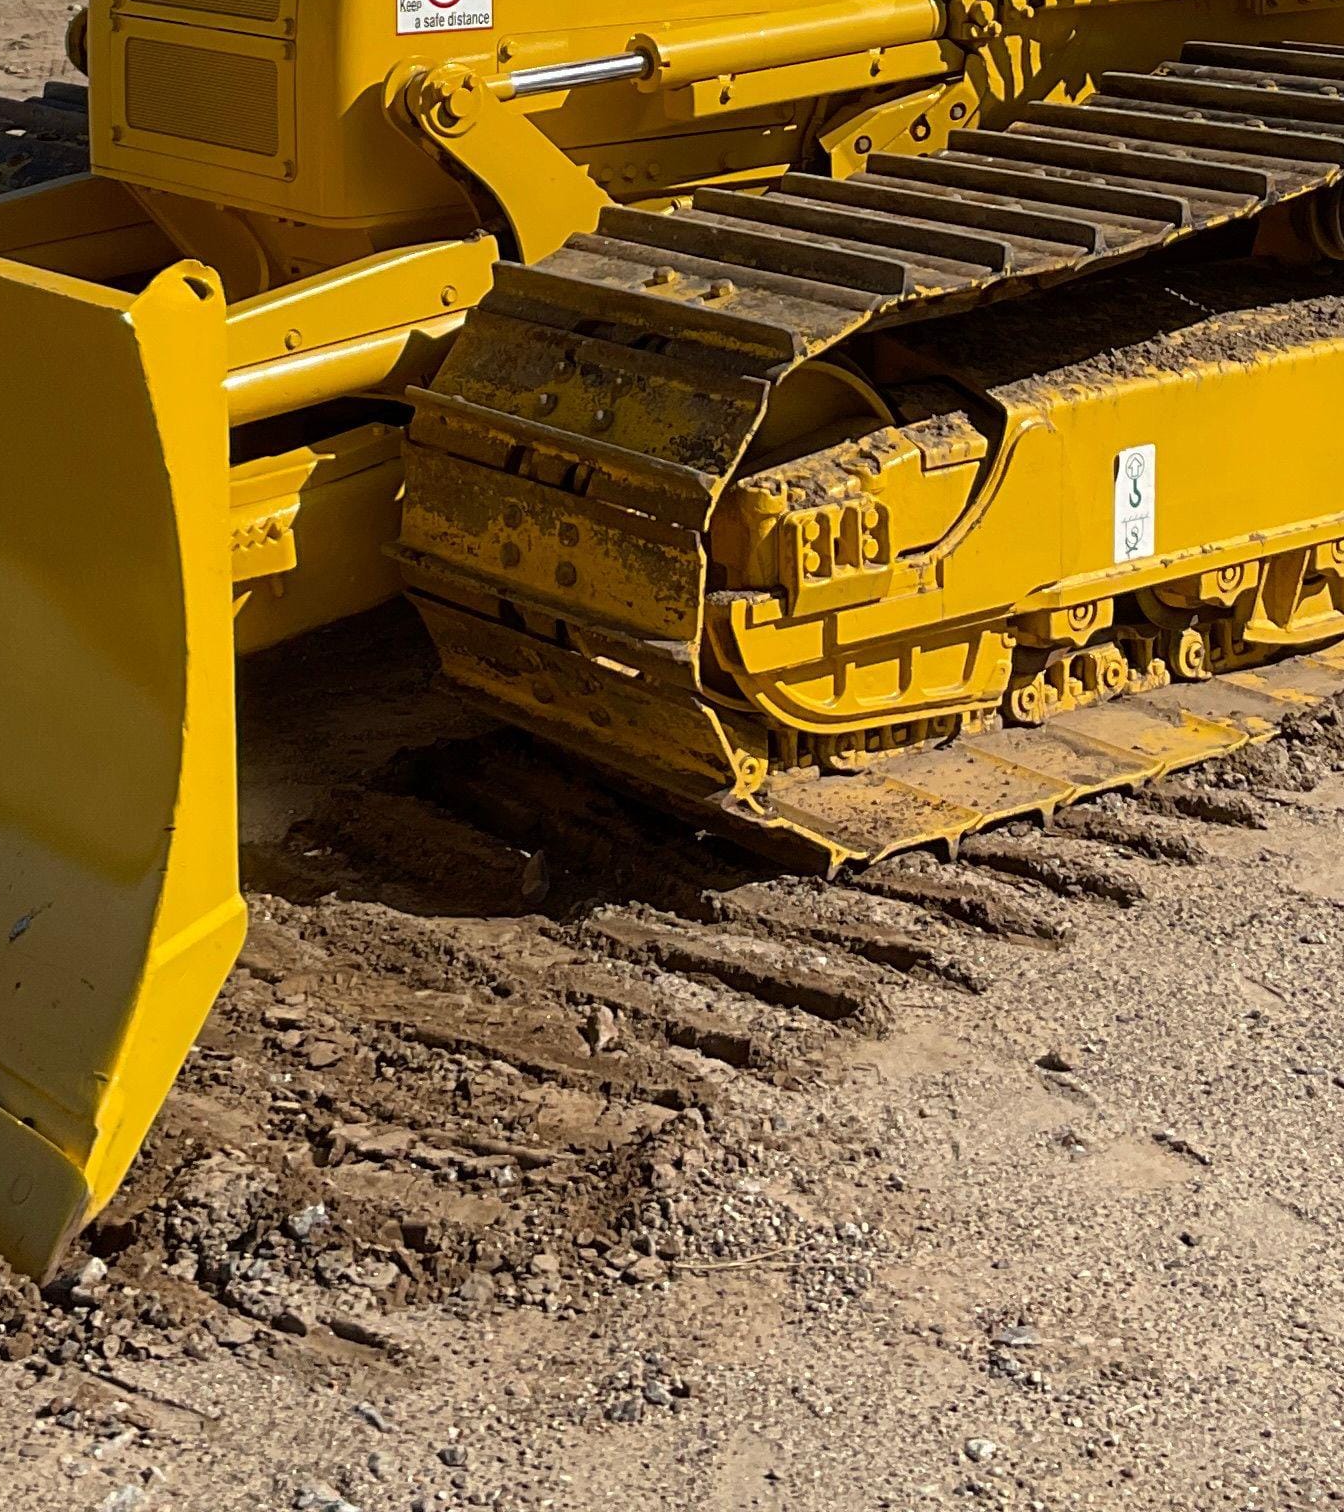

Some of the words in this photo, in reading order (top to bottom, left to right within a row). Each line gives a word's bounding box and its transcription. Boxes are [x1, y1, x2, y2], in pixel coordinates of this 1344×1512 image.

[414, 17, 421, 29] a
[424, 12, 444, 28] safe
[447, 10, 490, 26] distance
